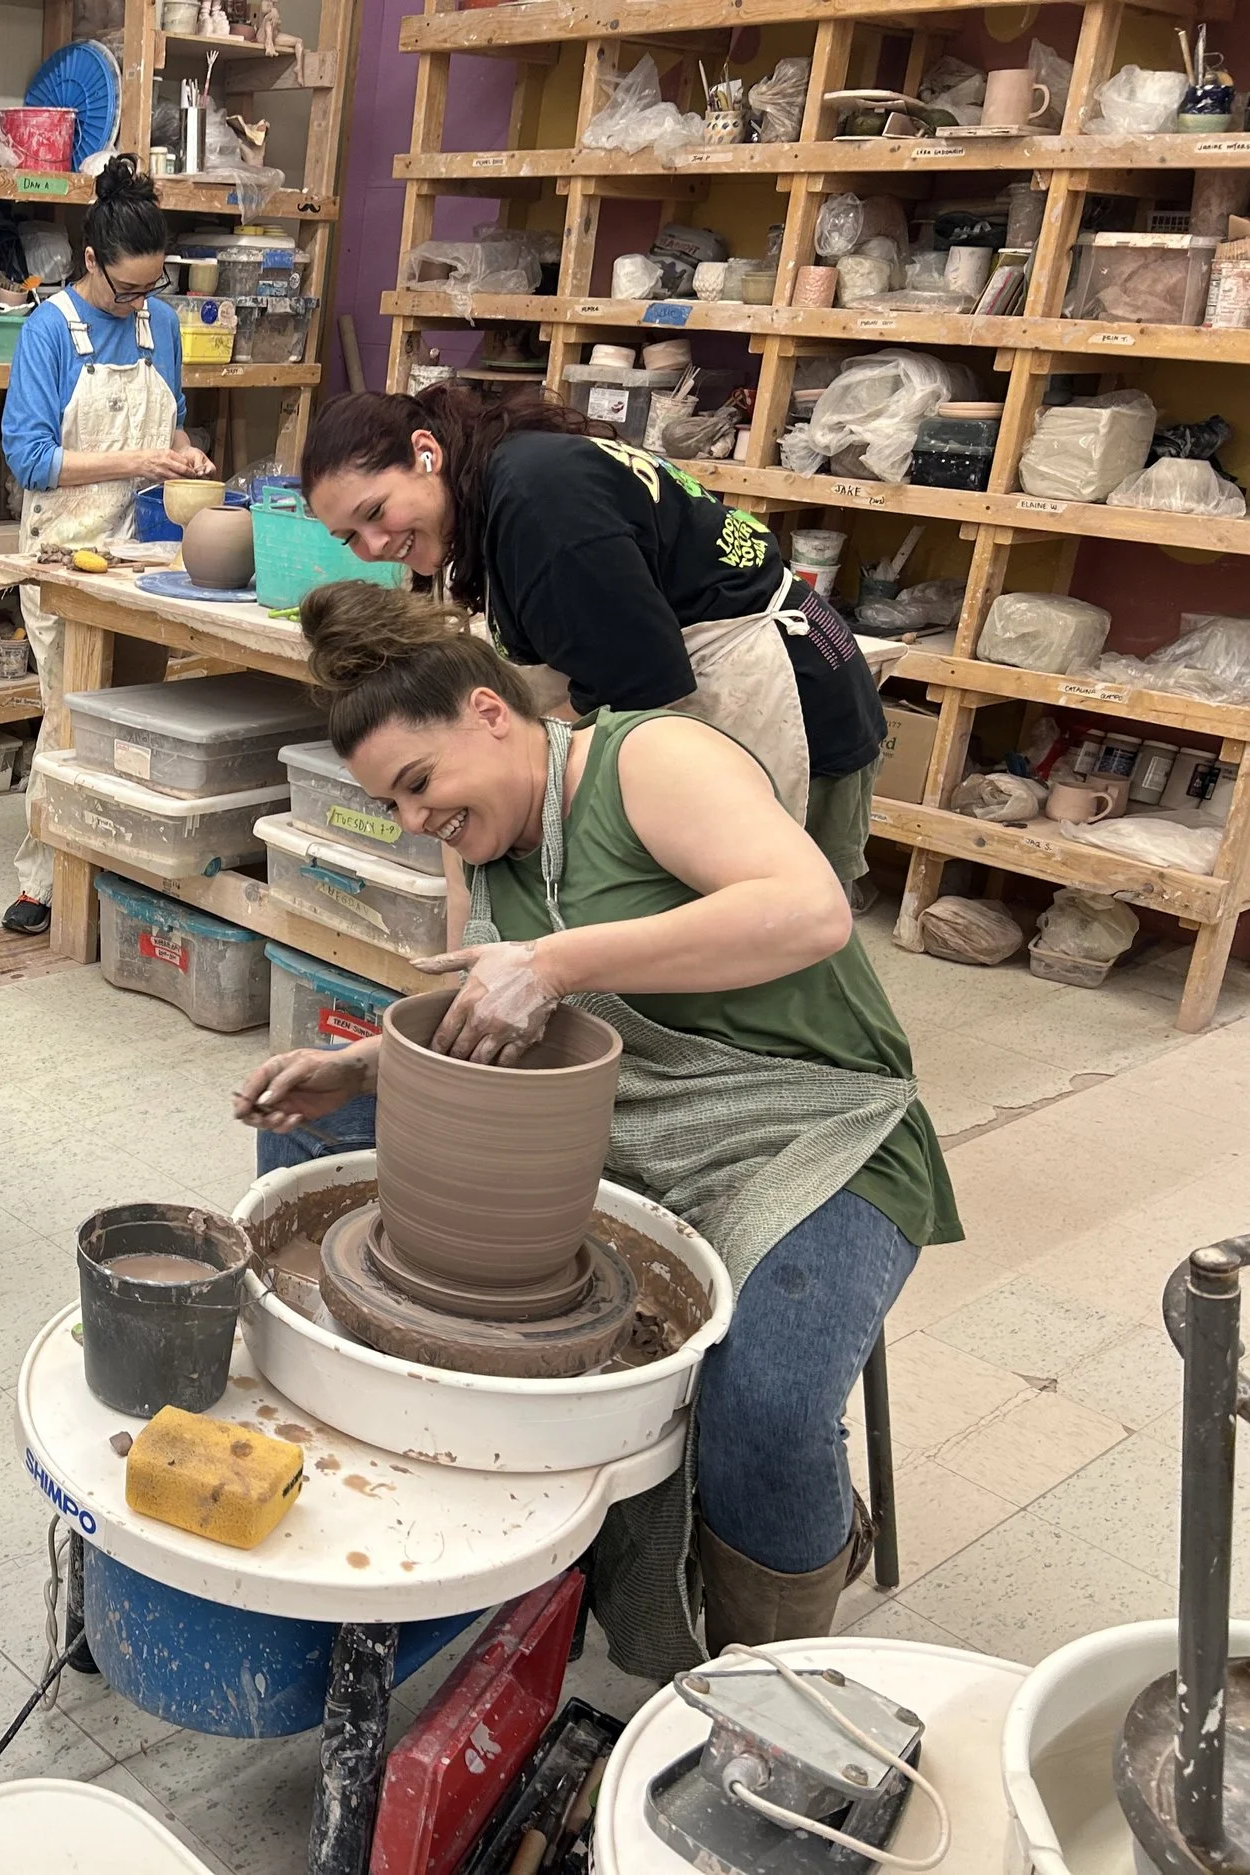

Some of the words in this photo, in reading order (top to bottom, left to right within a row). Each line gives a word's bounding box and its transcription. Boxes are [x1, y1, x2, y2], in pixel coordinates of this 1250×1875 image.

[834, 484, 862, 497] JAKE
[1021, 501, 1047, 510] ELAINE
[739, 522, 753, 569] TOUR
[1064, 685, 1096, 694] CATALINA
[880, 737, 897, 750] rd
[334, 812, 375, 834] TUESDAY
[322, 884, 369, 915] TUESDAY
[334, 1018, 351, 1029] TEEN
[353, 1025, 376, 1037] SUNDA
[25, 1447, 97, 1534] SHIMPO
